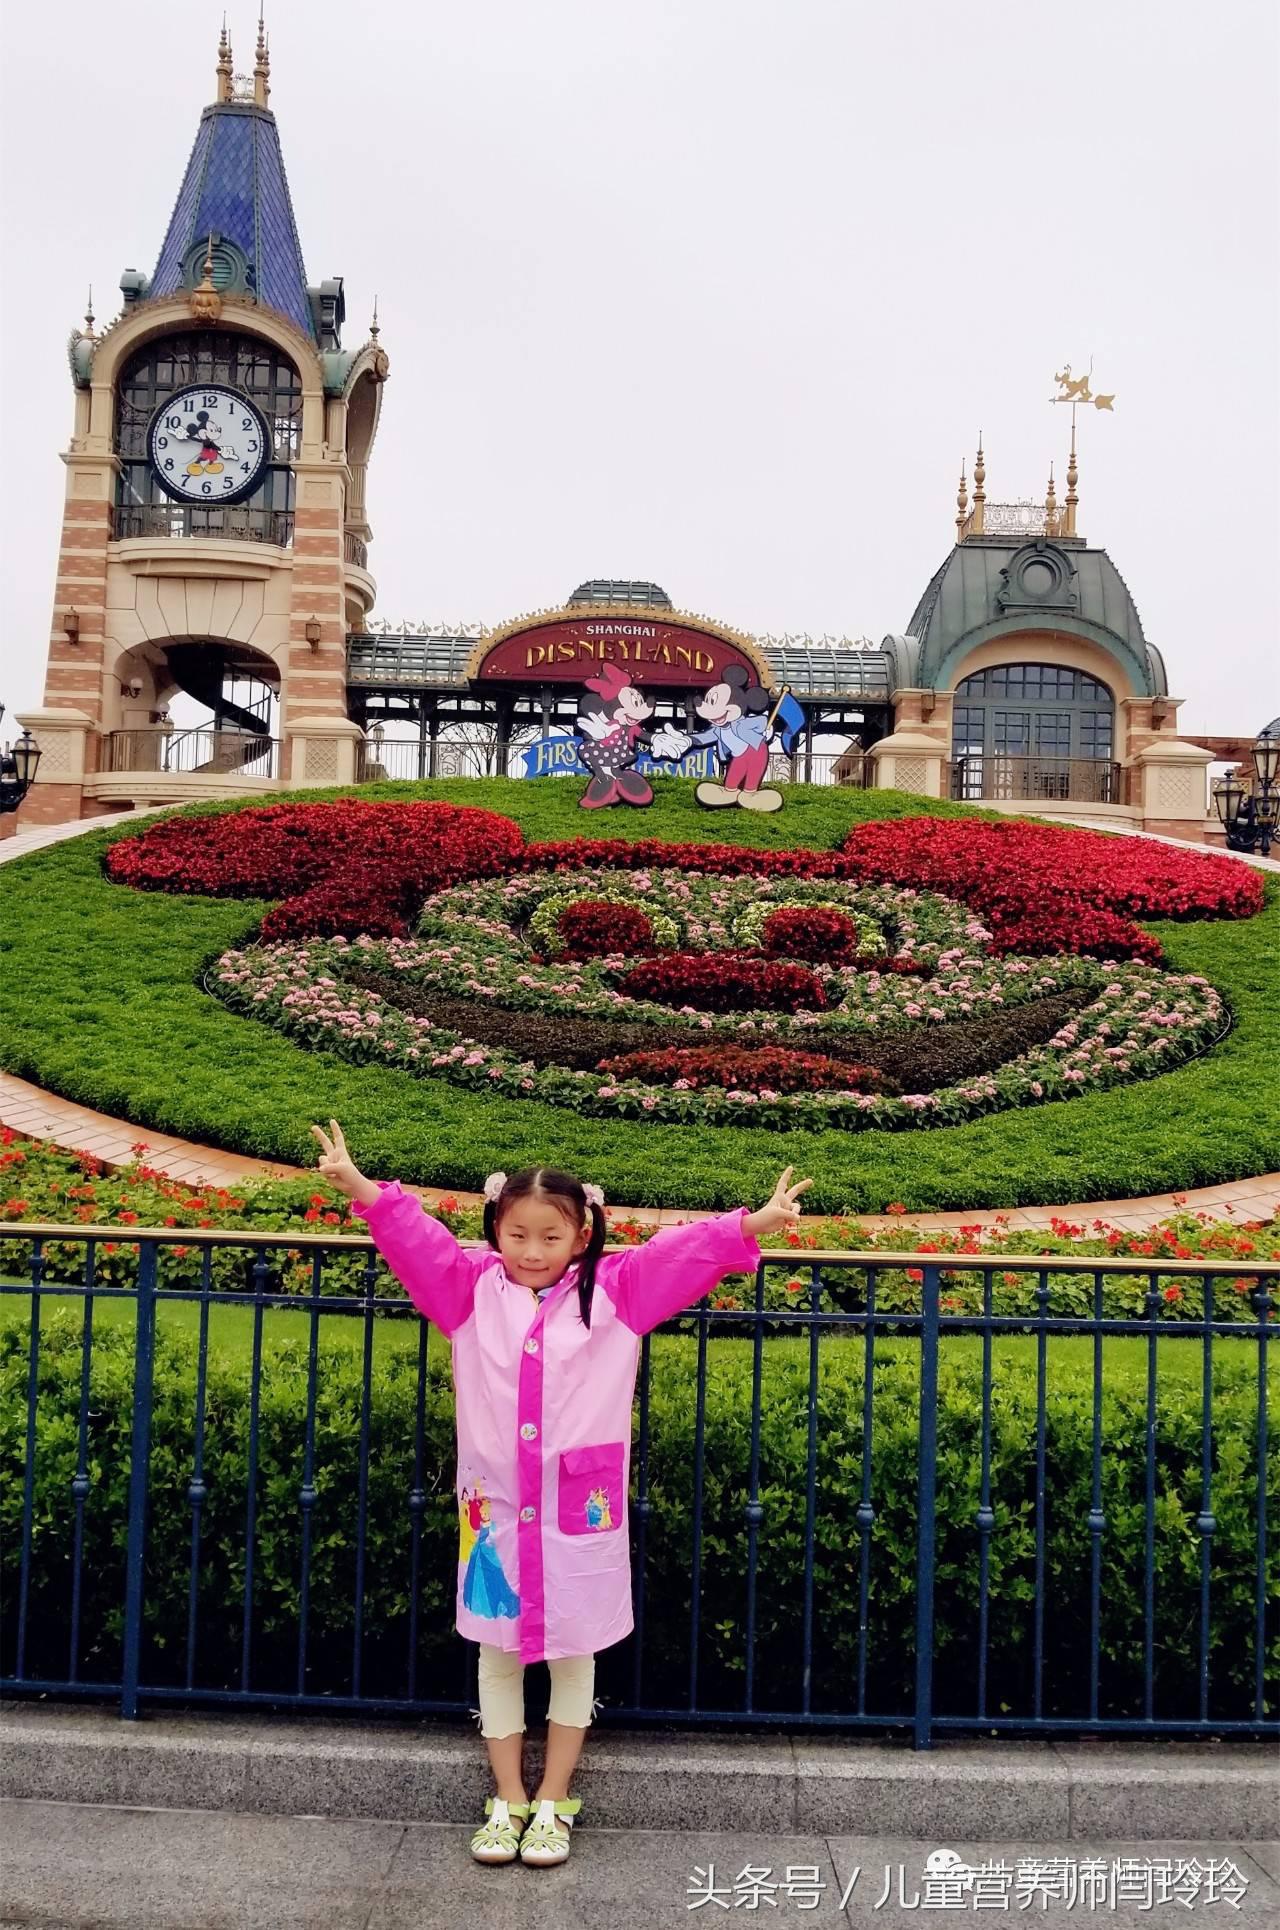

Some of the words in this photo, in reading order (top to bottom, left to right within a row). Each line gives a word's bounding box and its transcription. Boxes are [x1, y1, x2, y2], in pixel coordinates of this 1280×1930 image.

[183, 400, 194, 412] 11
[202, 395, 218, 408] 12
[228, 402, 235, 415] 1
[165, 416, 181, 428] 10
[242, 418, 253, 431] 2
[158, 437, 168, 450] 9
[247, 440, 258, 452] 3
[164, 458, 174, 470] 8
[240, 461, 250, 474] 4
[181, 474, 191, 487] 7
[223, 477, 234, 489] 5
[201, 481, 211, 494] 6
[586, 625, 657, 637] SHANGHAI
[525, 640, 715, 673] DISNEYLAND
[535, 740, 583, 774] FIRS
